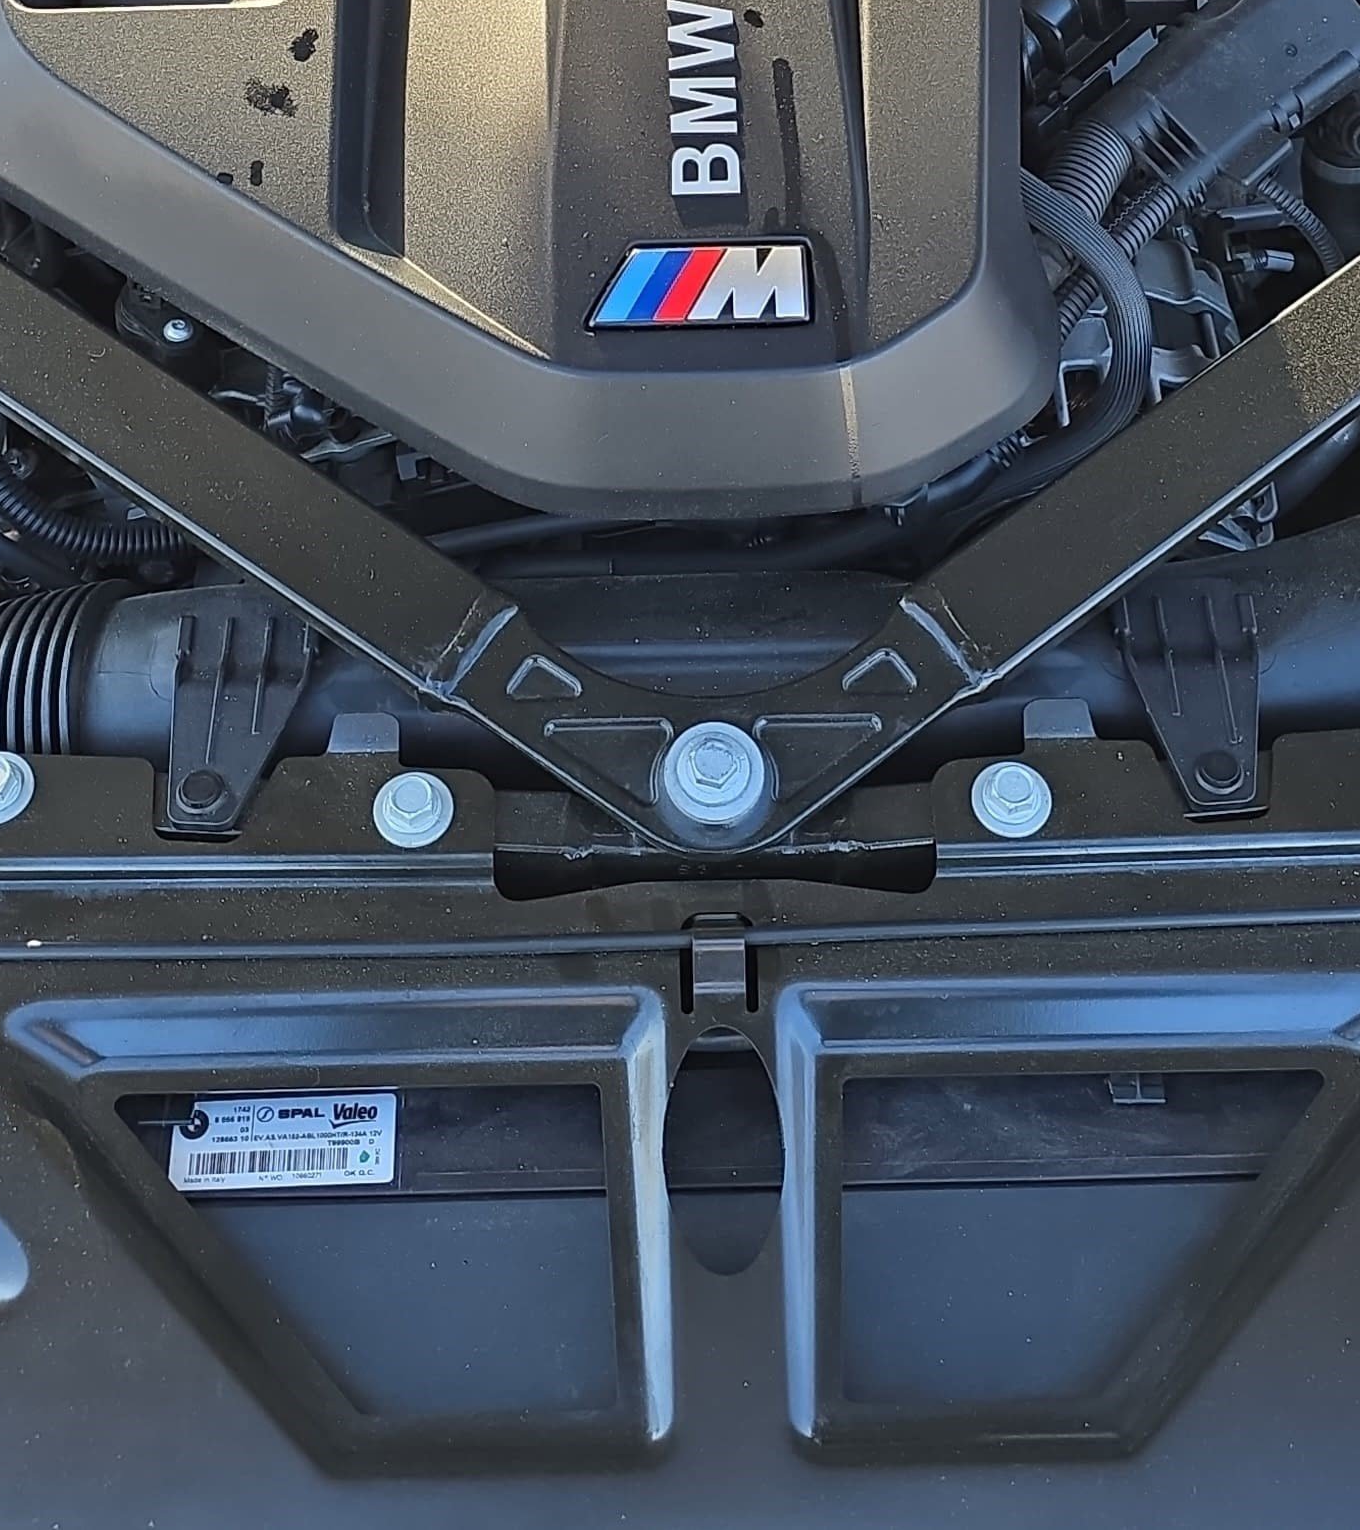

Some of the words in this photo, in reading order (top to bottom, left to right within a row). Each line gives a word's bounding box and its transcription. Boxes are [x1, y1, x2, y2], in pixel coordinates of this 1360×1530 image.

[666, 0, 742, 196] BMW
[687, 247, 806, 320] M
[277, 1107, 326, 1120] SPAL
[333, 1102, 378, 1121] Valeo
